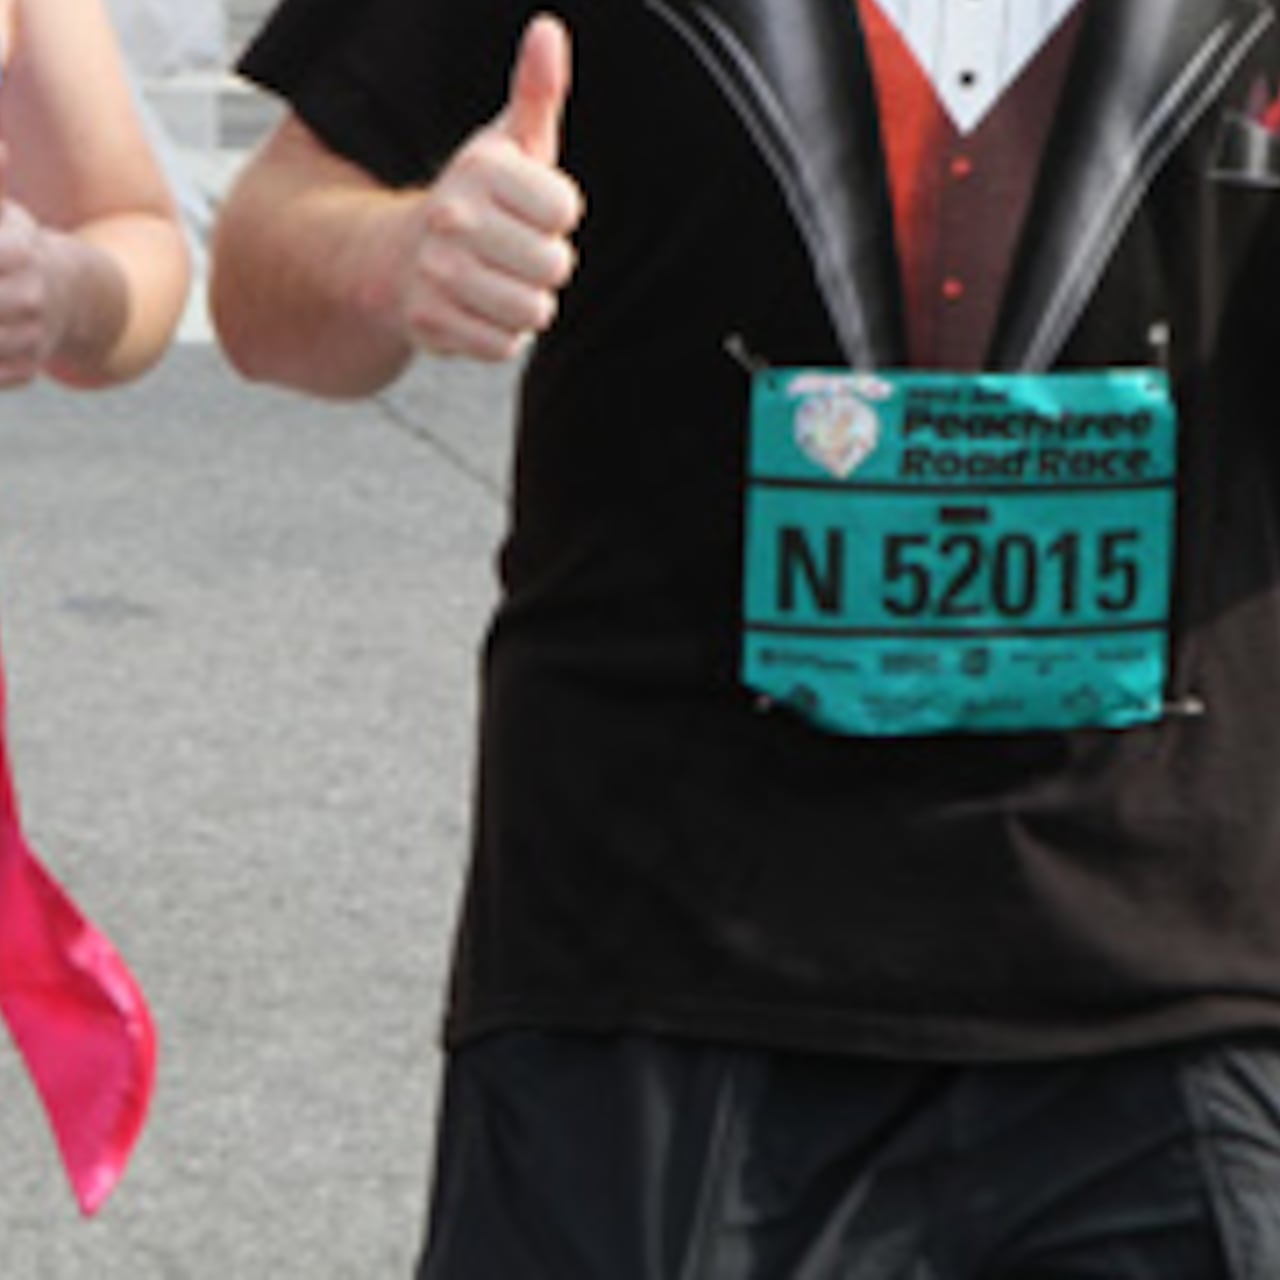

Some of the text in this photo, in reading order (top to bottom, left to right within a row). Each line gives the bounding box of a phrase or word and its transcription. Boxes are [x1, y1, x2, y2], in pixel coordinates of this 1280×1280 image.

[903, 405, 1154, 440] Peachtree
[901, 447, 1153, 477] Road Race
[775, 525, 1142, 618] N 52015
